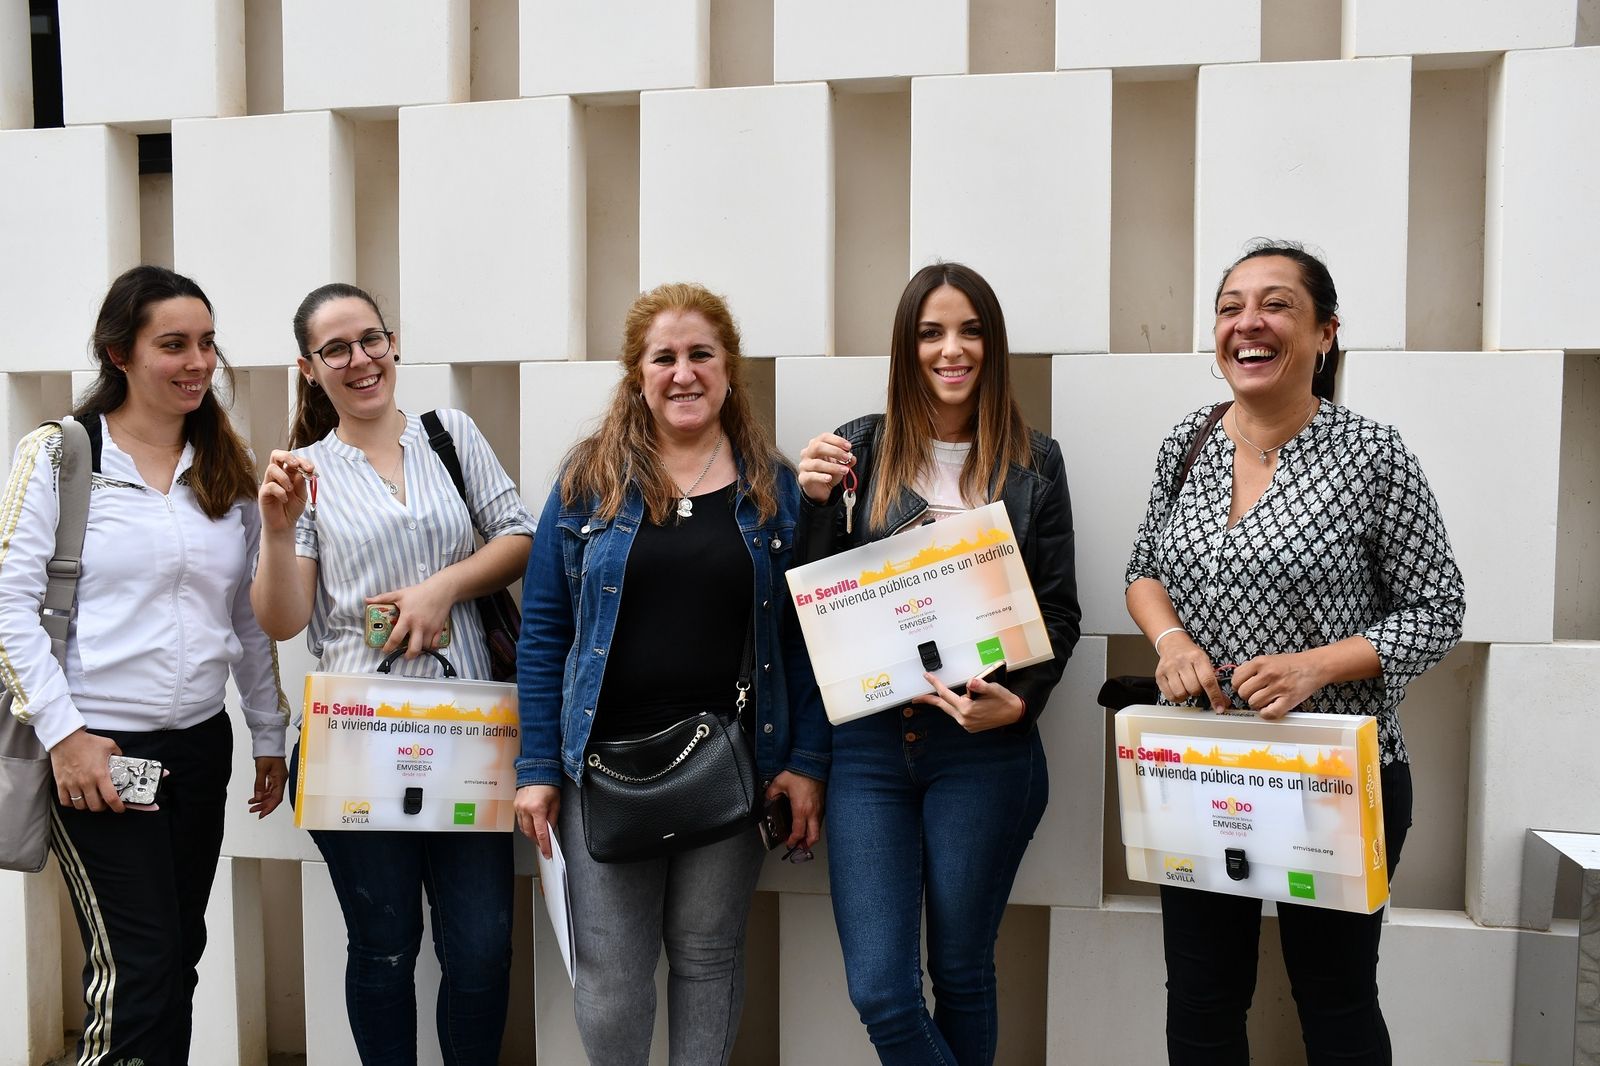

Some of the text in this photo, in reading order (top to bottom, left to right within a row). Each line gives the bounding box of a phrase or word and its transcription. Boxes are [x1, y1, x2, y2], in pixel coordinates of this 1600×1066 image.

[815, 542, 1015, 616] la vivienda pública no es un ladrillo
[795, 577, 859, 607] En Sevilla
[975, 605, 1012, 621] emvisesa.org
[899, 614, 938, 631] EMVISESA
[312, 702, 374, 717] En Sevilla
[327, 717, 518, 738] la vivienda pública no es un ladrillo
[1118, 746, 1181, 763] En Sevilla
[396, 763, 433, 772] EMVISESA
[464, 778, 498, 786] emvisesa.org
[1135, 763, 1353, 796] la vivienda pública no es un ladrillo
[1212, 820, 1253, 831] EMVISESA
[1292, 845, 1334, 856] emvisesa.org
